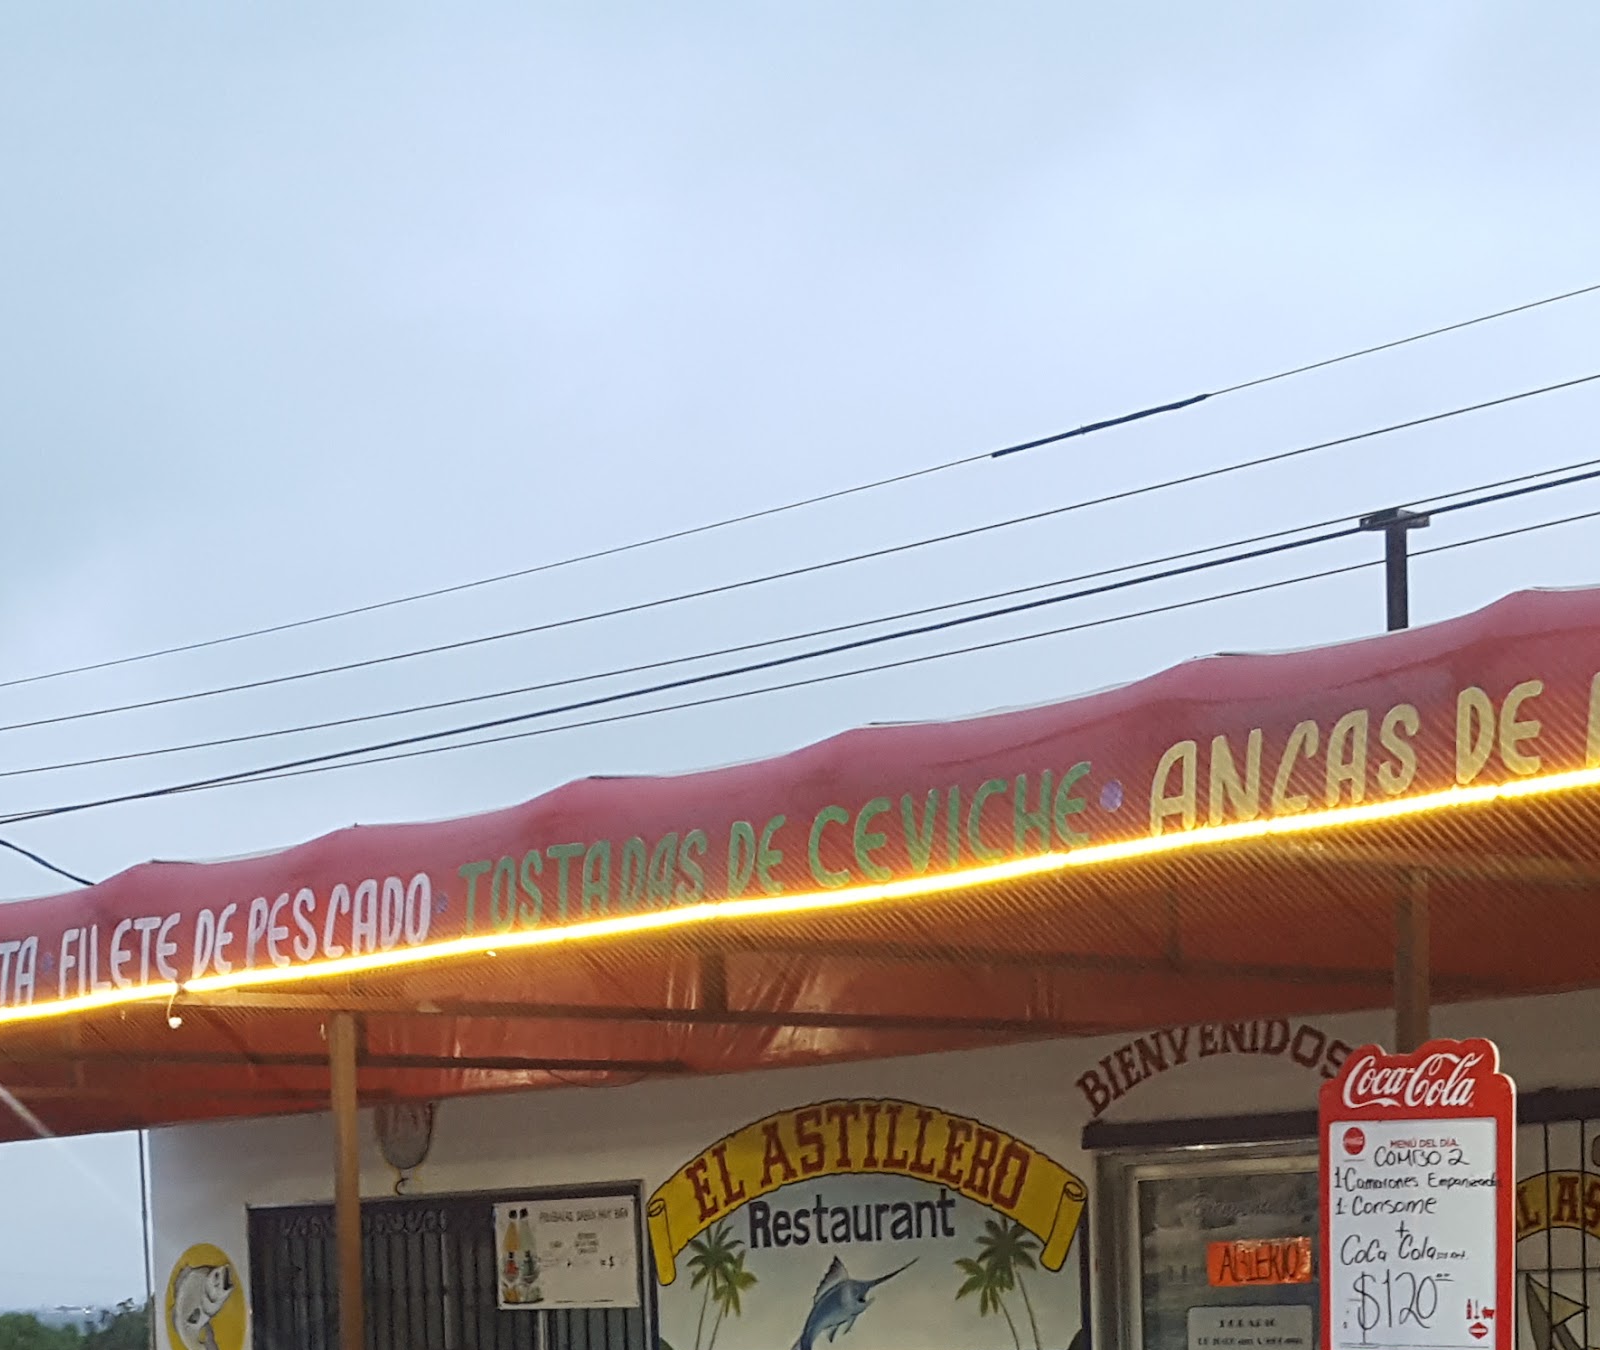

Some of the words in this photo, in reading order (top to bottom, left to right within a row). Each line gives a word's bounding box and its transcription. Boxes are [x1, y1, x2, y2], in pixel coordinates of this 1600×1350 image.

[58, 912, 181, 999] FILETE
[191, 902, 237, 979] DE
[246, 872, 432, 969] PESCADO
[458, 829, 706, 936] TOSTADAS
[728, 814, 786, 898] DE
[807, 762, 1093, 889] CEVICHE
[1150, 704, 1420, 835] ANCAS
[1455, 679, 1543, 785] DE
[1075, 1018, 1354, 1118] BIENVENIDOS
[1343, 1053, 1485, 1109] Coca-Cola
[685, 1142, 747, 1224] EL
[761, 1103, 1032, 1210] ASTILLERO
[1419, 1139, 1436, 1148] DEL
[1448, 1148, 1470, 1166] 2
[750, 1188, 956, 1249] Restaurant
[1516, 1185, 1541, 1232] L
